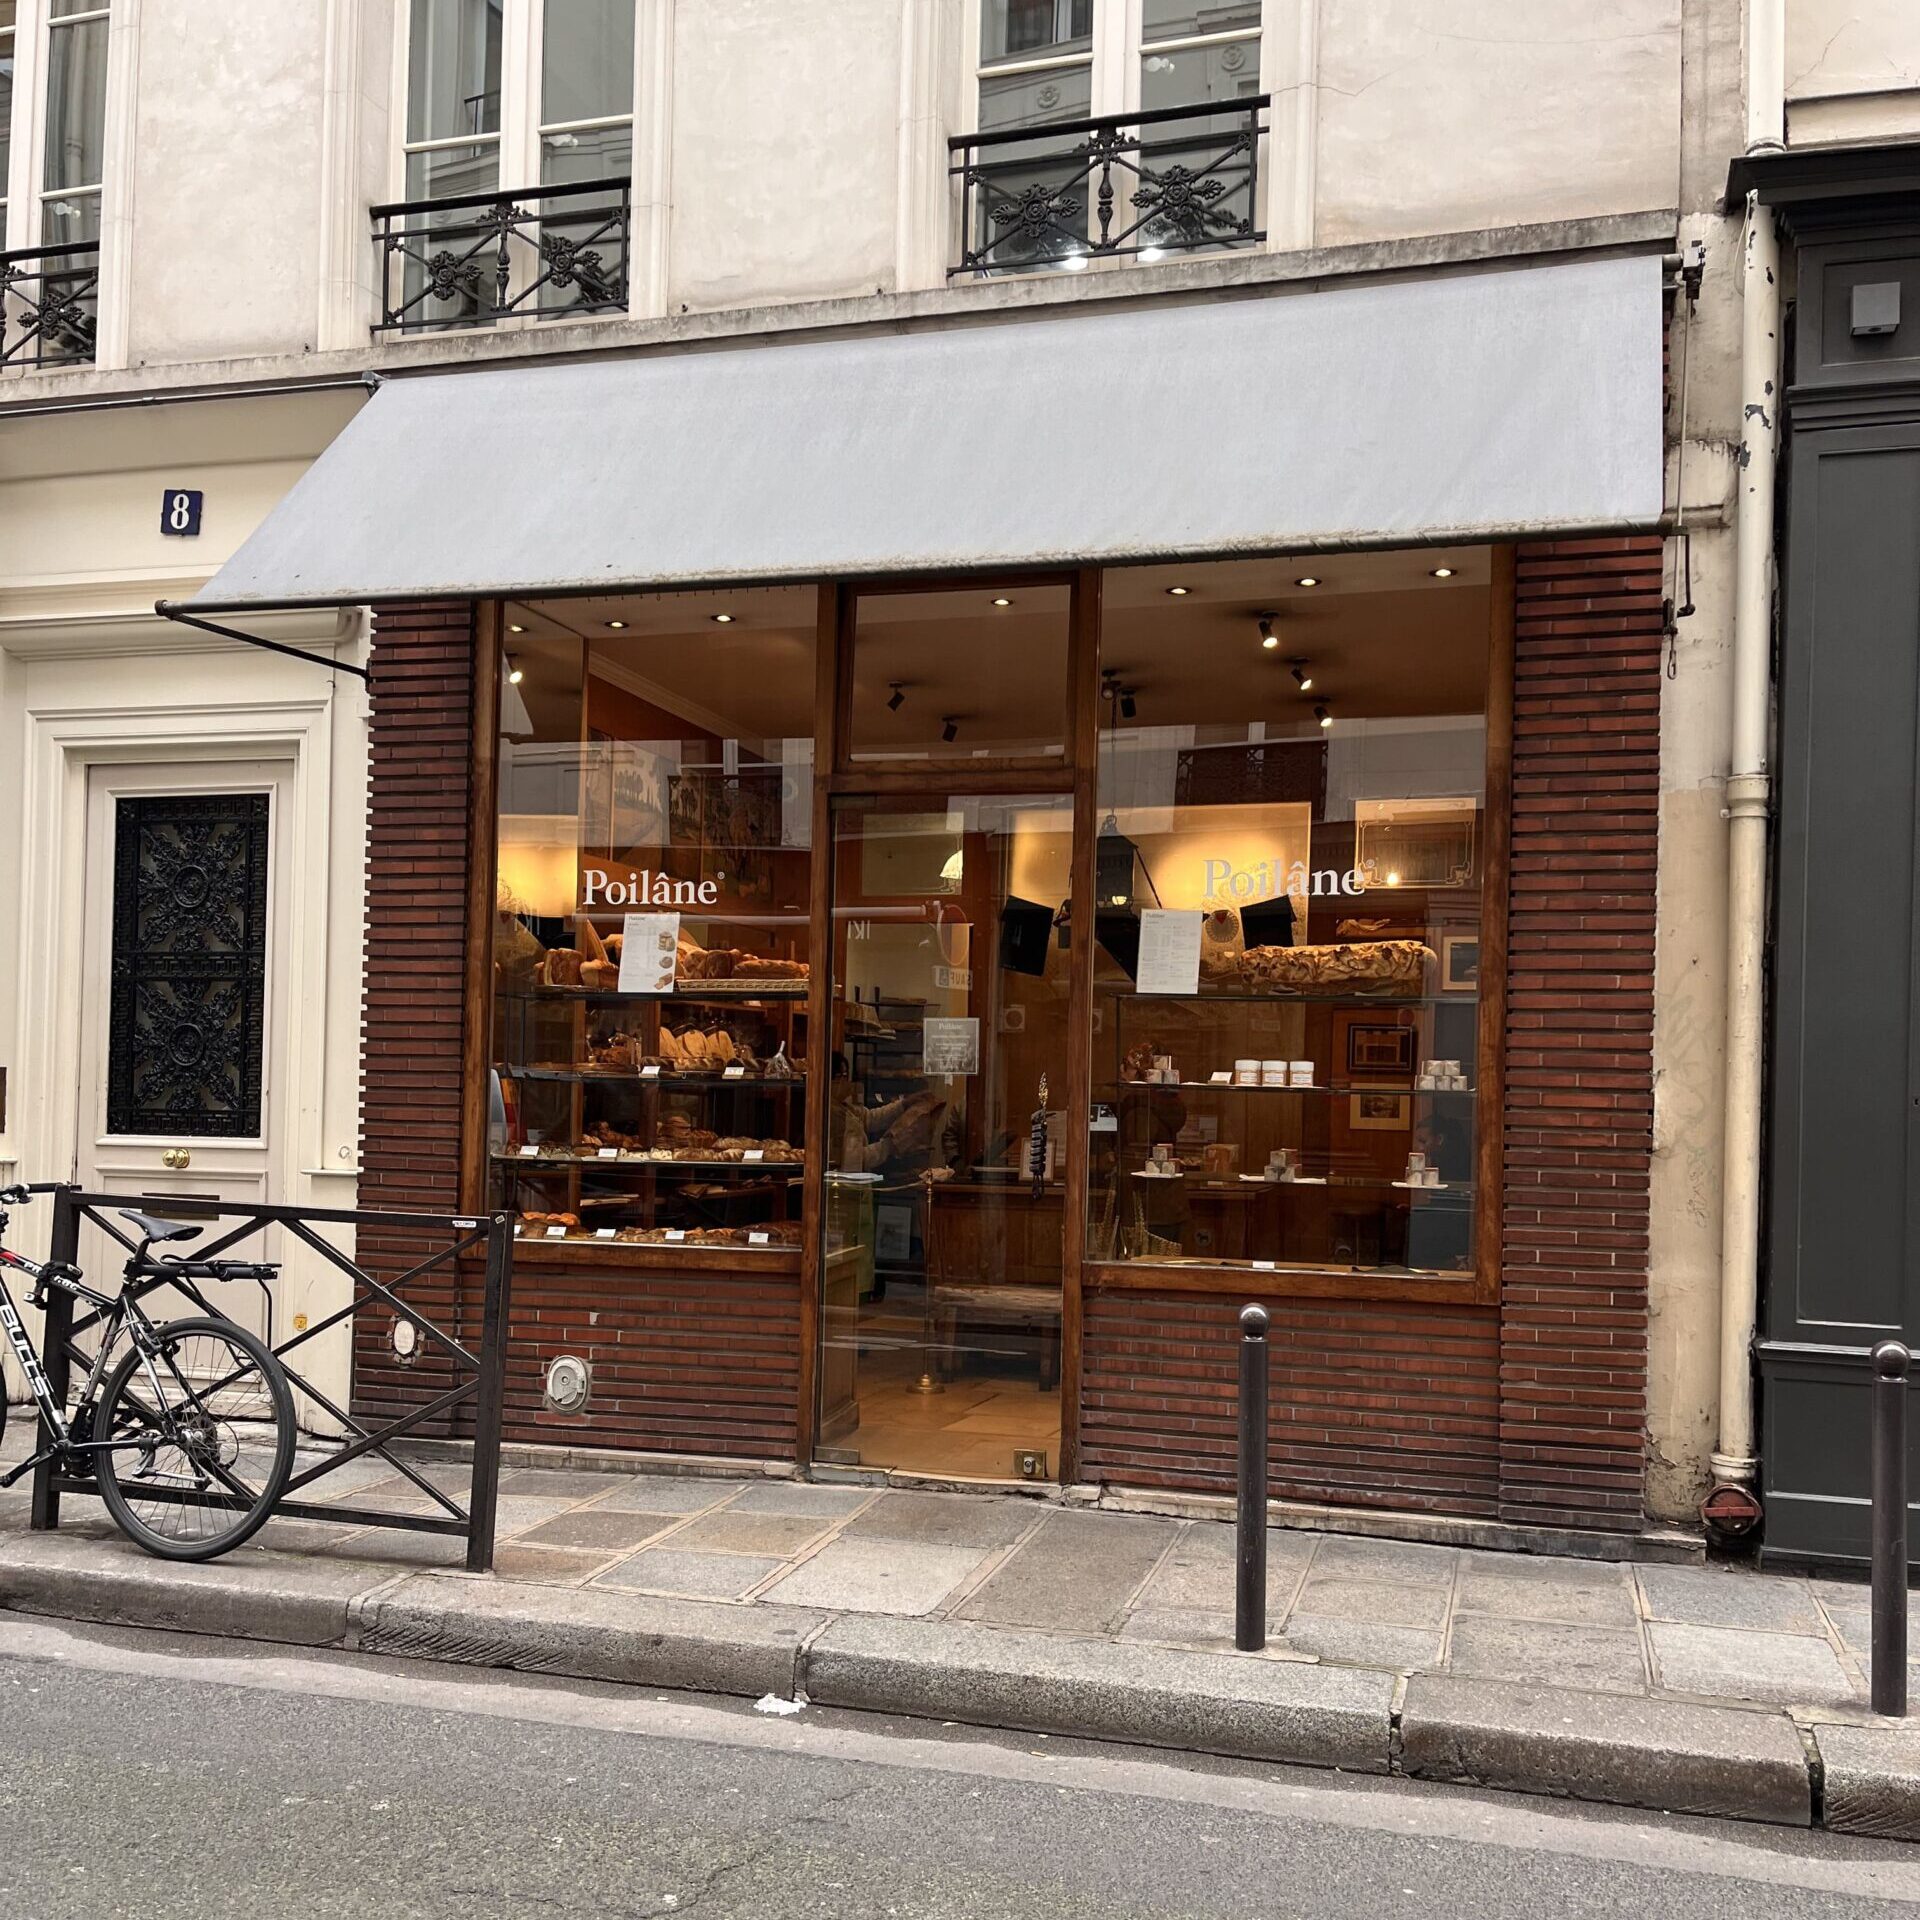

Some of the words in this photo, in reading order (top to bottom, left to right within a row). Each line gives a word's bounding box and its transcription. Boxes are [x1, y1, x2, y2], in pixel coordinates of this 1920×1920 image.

[170, 493, 190, 530] 8
[582, 869, 718, 905] Poilâne
[1203, 859, 1365, 898] Poilâne
[0, 1304, 51, 1397] BULLS
